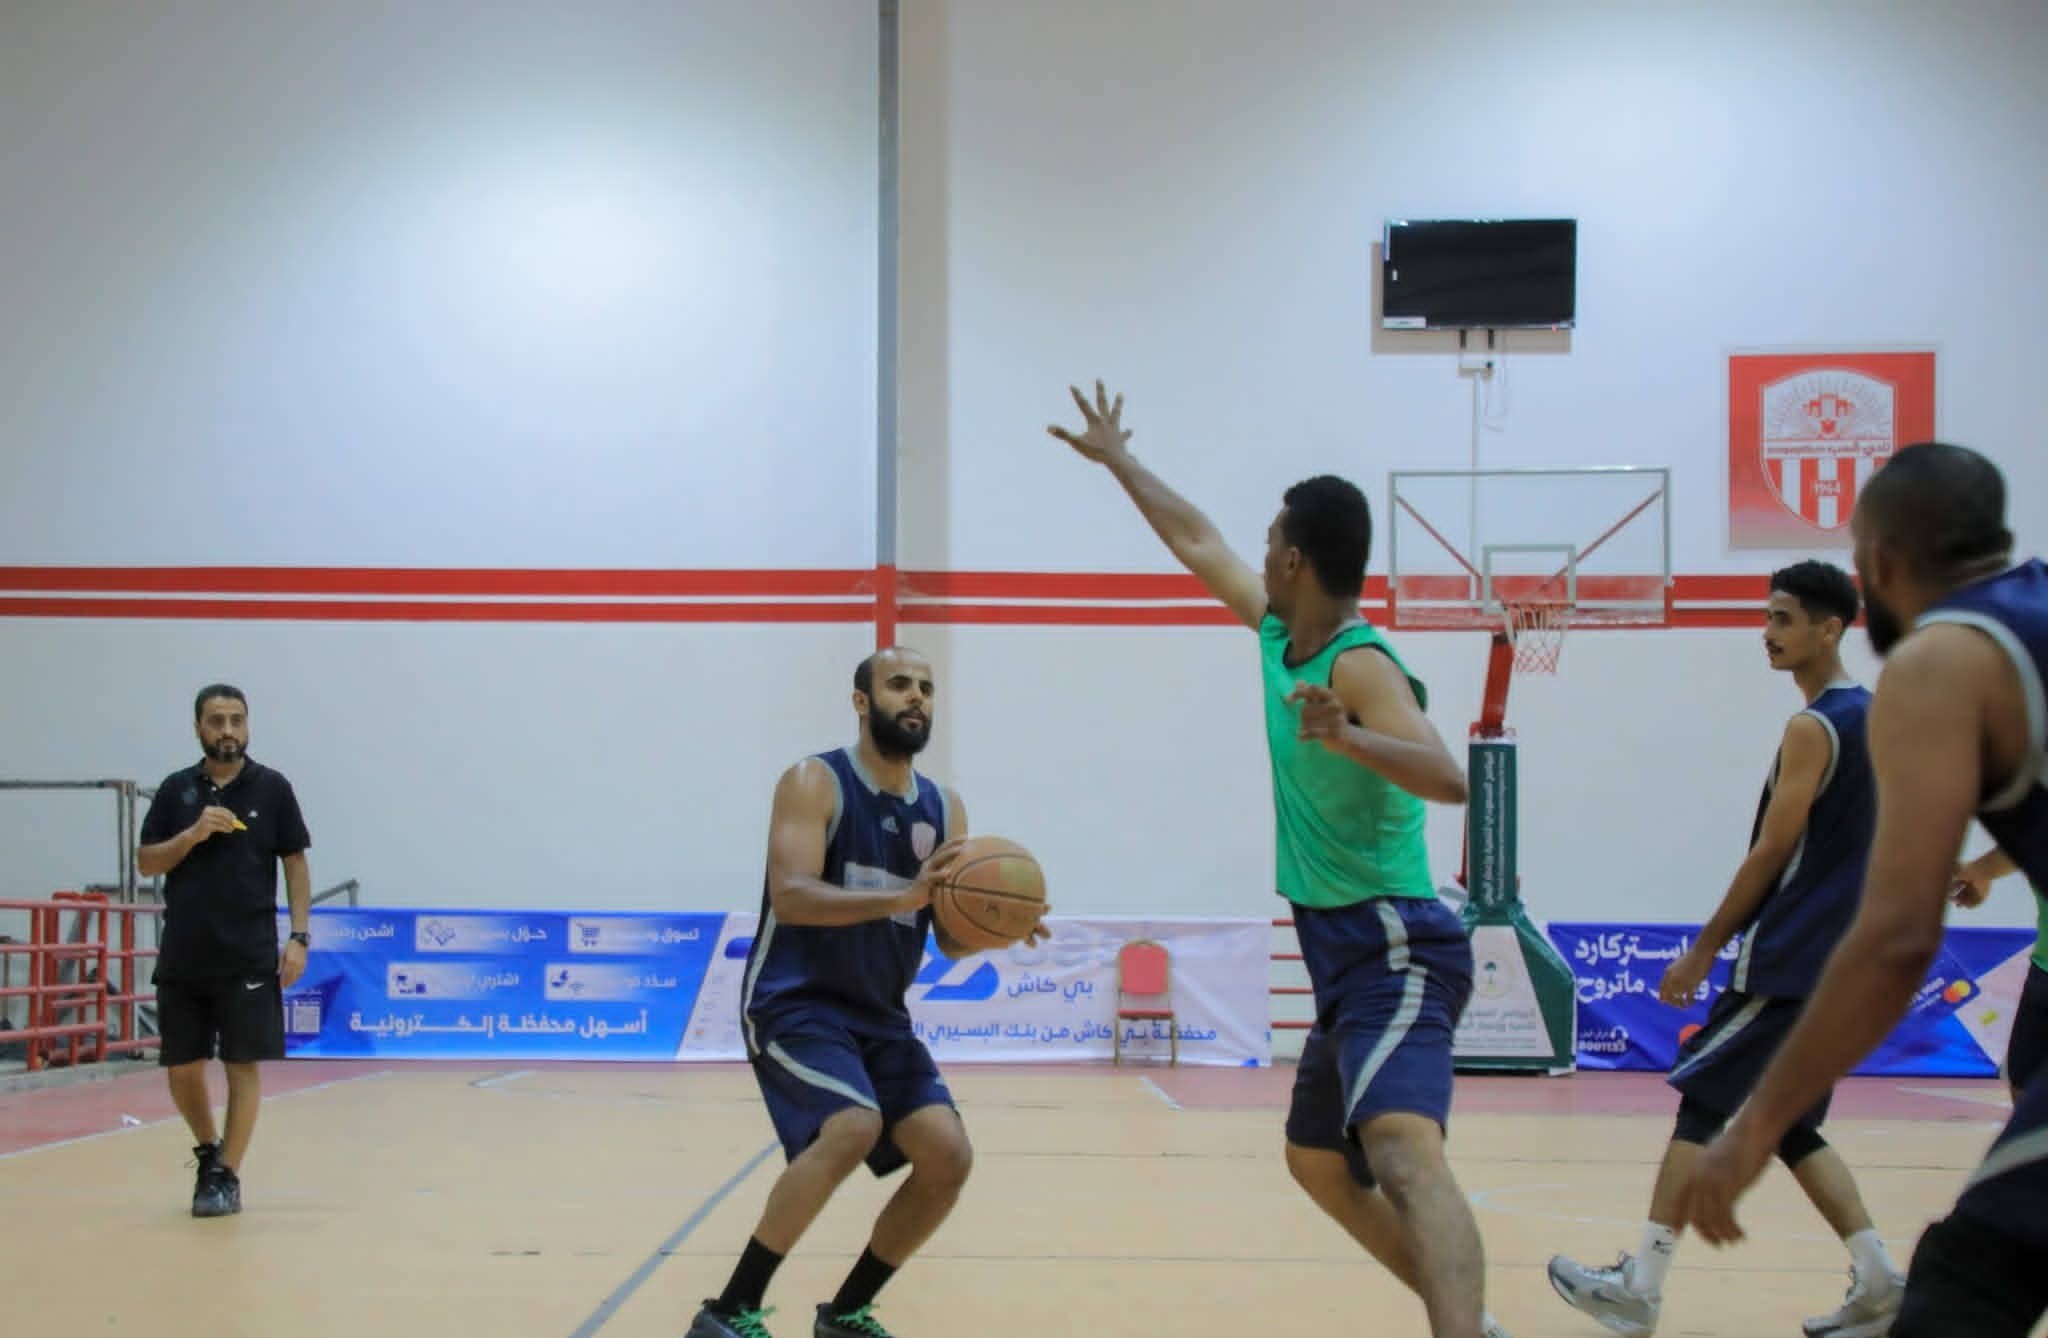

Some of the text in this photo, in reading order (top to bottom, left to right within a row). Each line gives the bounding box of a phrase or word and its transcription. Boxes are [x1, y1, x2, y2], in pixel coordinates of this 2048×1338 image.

[1575, 933, 1689, 967] استركارد
[1007, 970, 1093, 1003] بي كاش
[1575, 969, 1645, 1004] ماتروح
[350, 1009, 648, 1039] أسهل محفظة إلكترونية
[928, 1022, 999, 1047] البسيري
[1003, 1022, 1037, 1043] بنك
[1041, 1024, 1070, 1042] من
[1073, 1018, 1112, 1042] كاش
